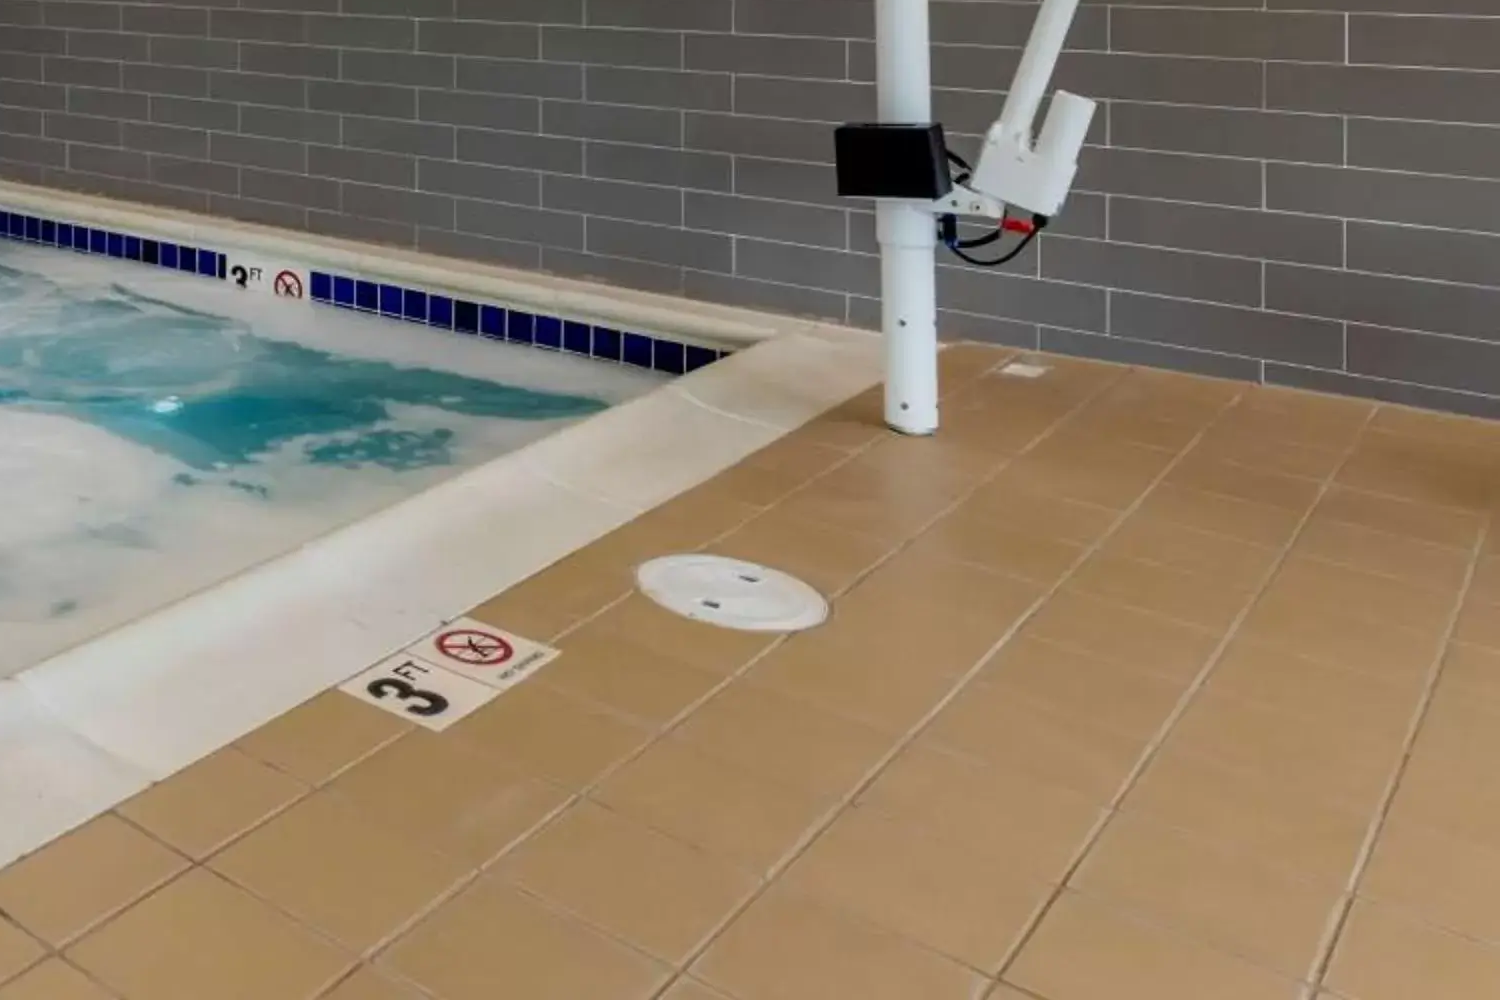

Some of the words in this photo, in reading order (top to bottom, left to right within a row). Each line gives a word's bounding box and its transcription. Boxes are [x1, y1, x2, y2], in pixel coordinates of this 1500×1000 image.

[250, 267, 263, 281] FT
[392, 660, 430, 682] FT
[367, 678, 449, 717] 3
